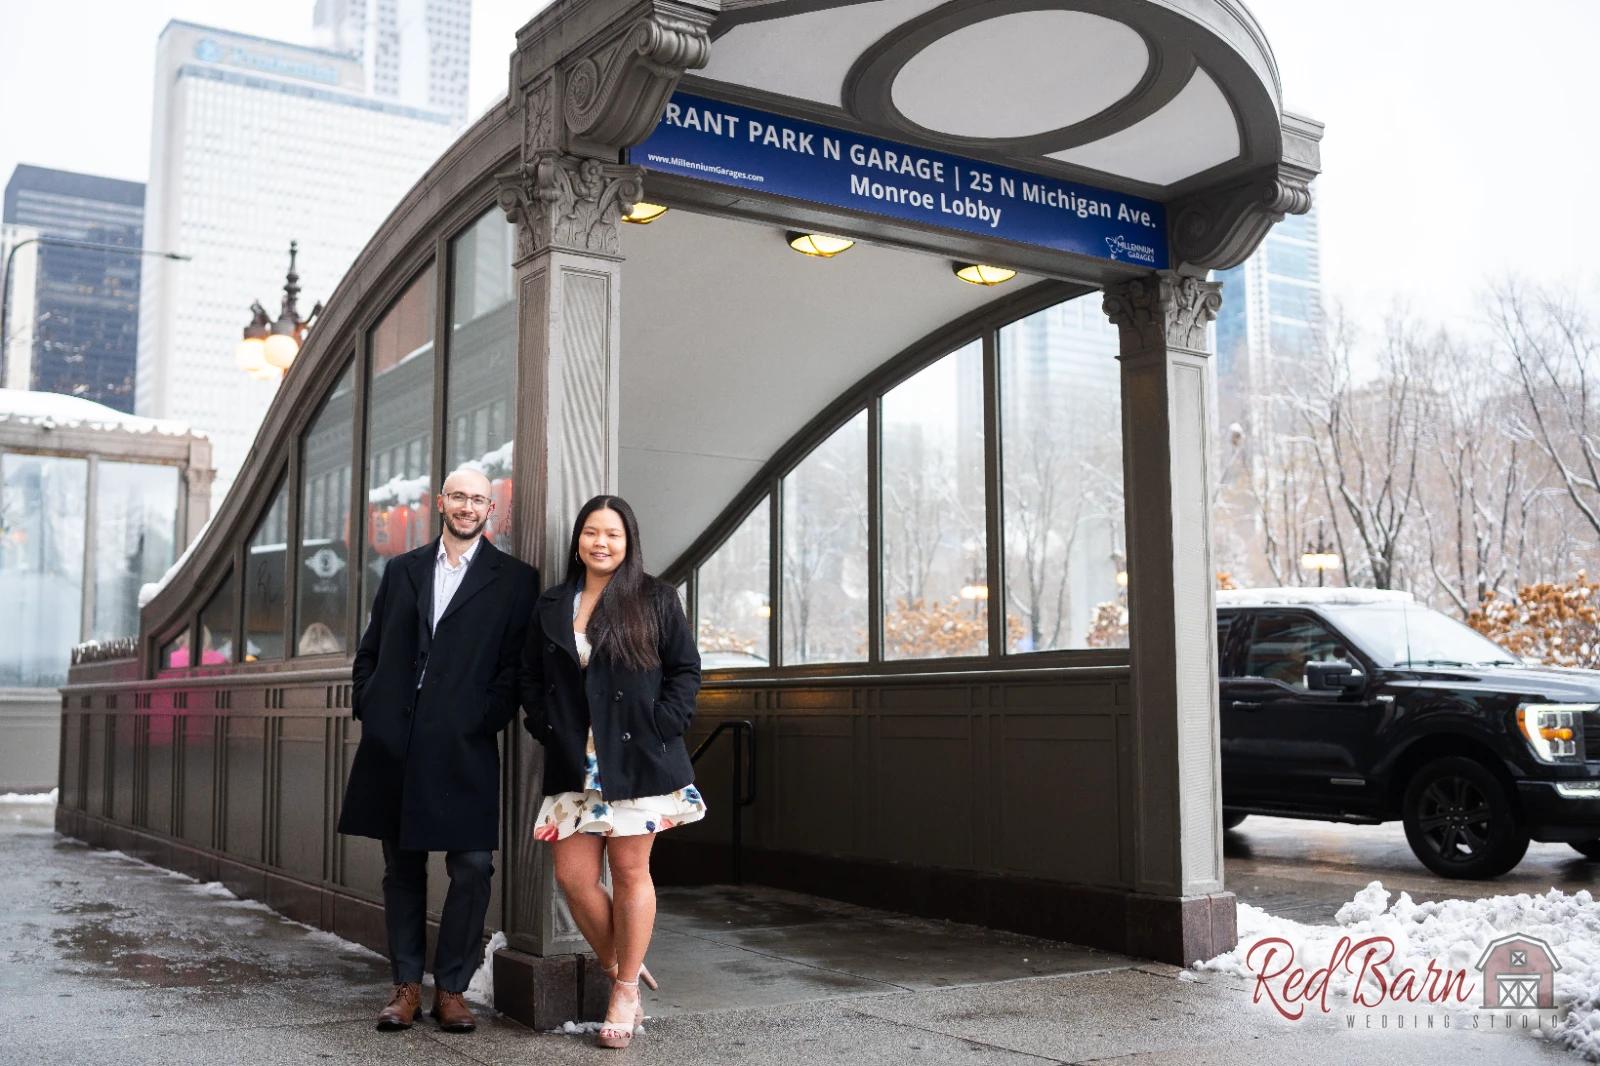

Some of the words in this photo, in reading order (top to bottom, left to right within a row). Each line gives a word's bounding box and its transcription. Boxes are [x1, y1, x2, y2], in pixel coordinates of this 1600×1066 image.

[647, 153, 764, 183] www.MillenniumGarages.com
[659, 101, 739, 138] RANT
[749, 120, 815, 156] PARK
[823, 137, 841, 161] N
[850, 144, 944, 183] GARAGE
[969, 170, 994, 193] 25
[1000, 176, 1015, 198] N
[1022, 182, 1111, 219] Michigan
[1117, 202, 1156, 228] Ave.
[850, 173, 934, 210] Monroe
[940, 192, 1002, 228] Lobby
[1117, 241, 1155, 255] MILLENNIUM
[1127, 250, 1155, 263] GARAGES
